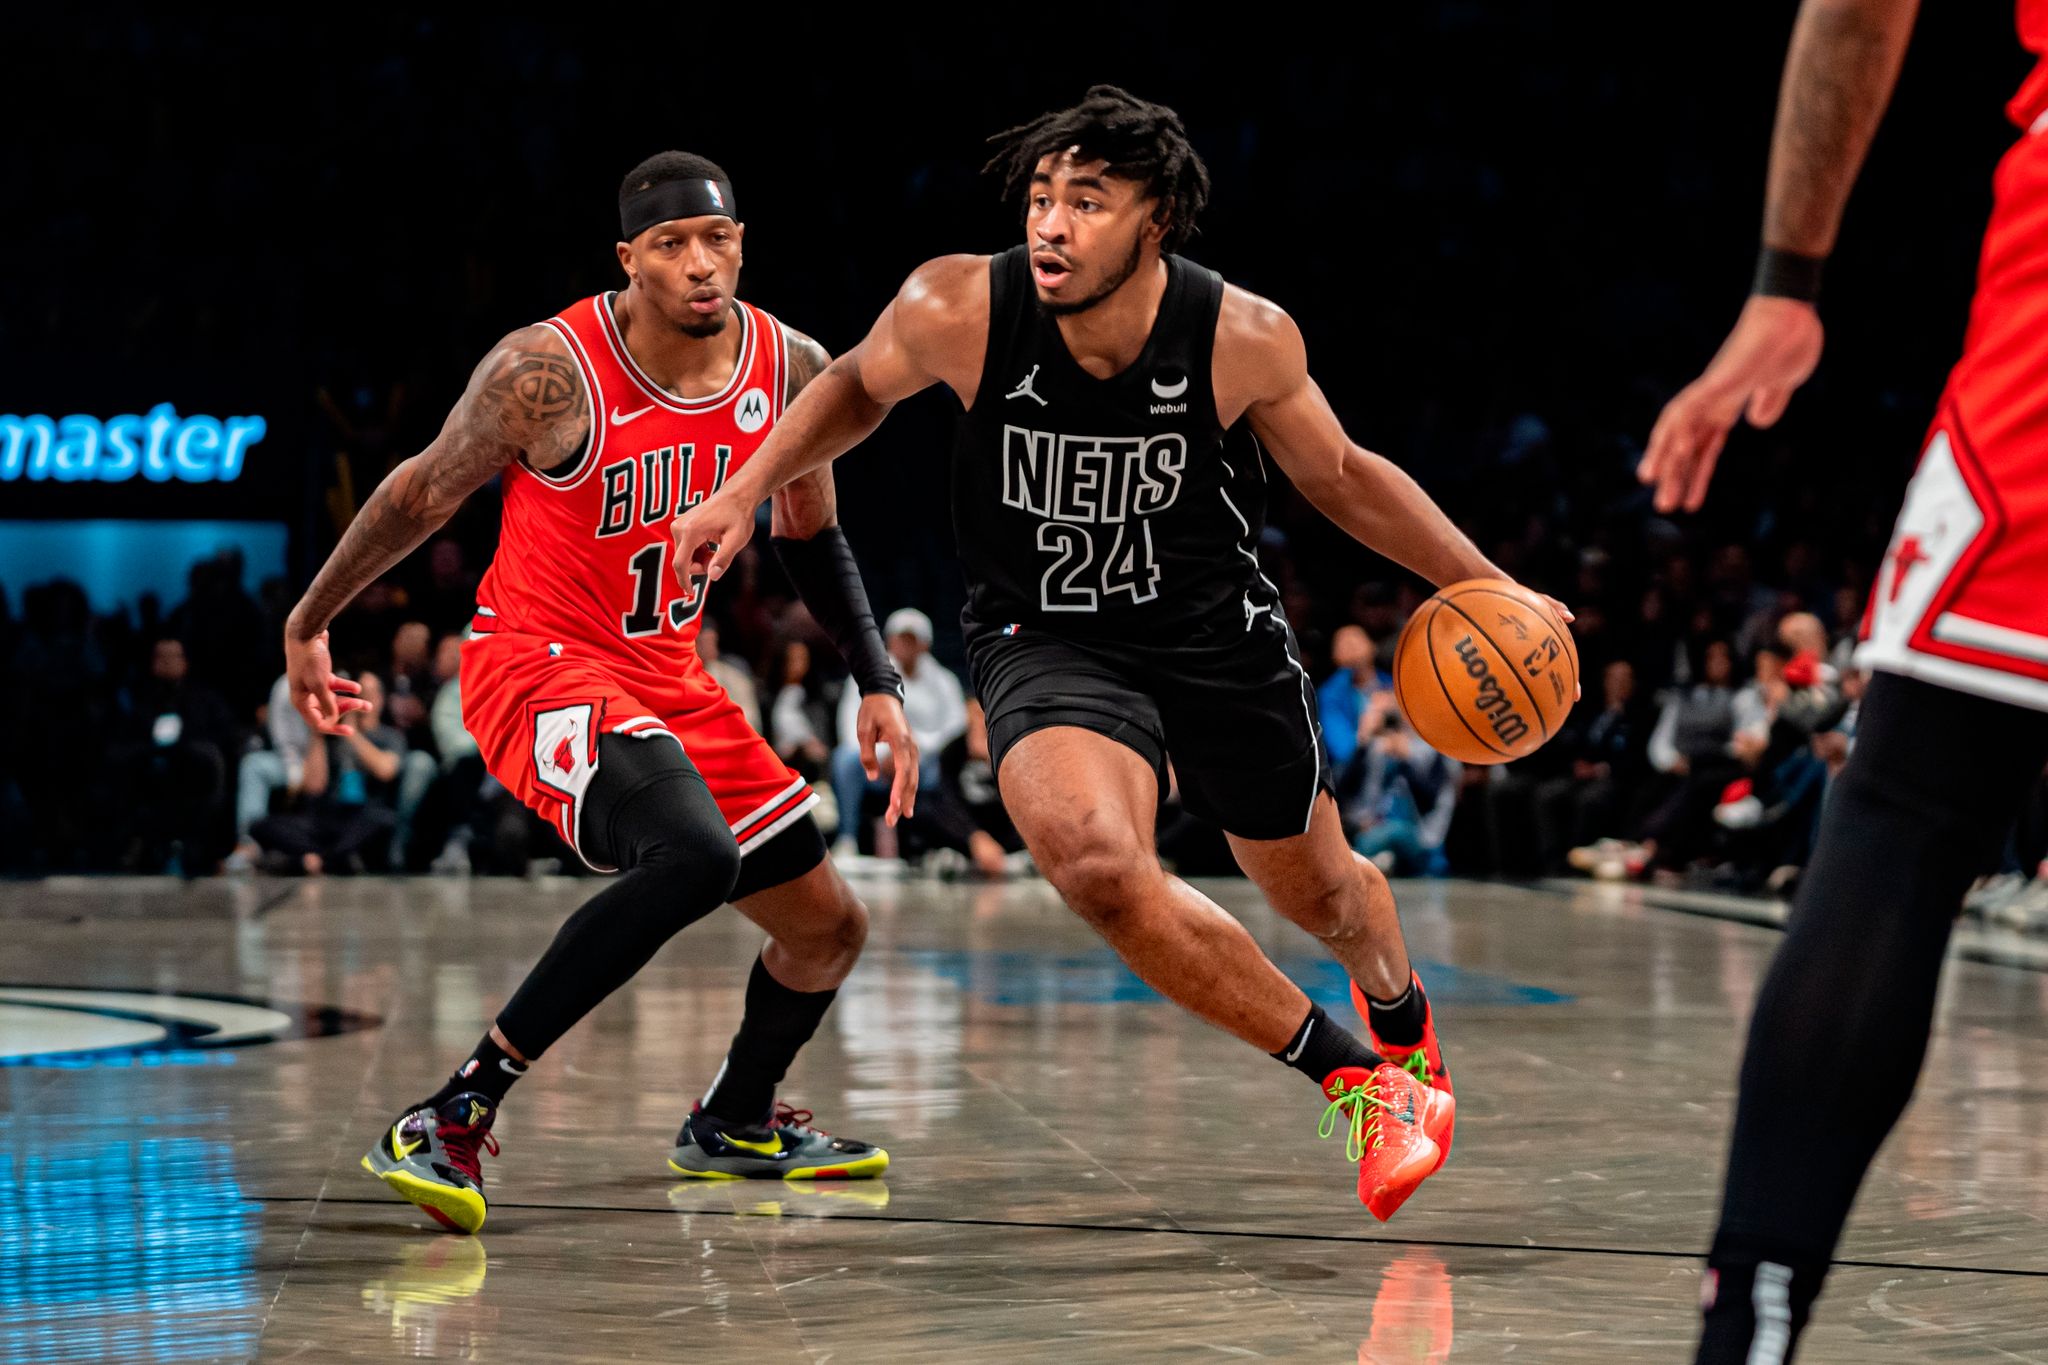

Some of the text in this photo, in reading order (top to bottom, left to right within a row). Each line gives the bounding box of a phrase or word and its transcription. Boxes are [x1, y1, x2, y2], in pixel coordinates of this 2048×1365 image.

[1149, 403, 1187, 415] Webull
[595, 443, 732, 539] BULL
[1002, 424, 1187, 523] NETS
[1037, 519, 1161, 612] 24
[1455, 634, 1529, 746] Wilson
